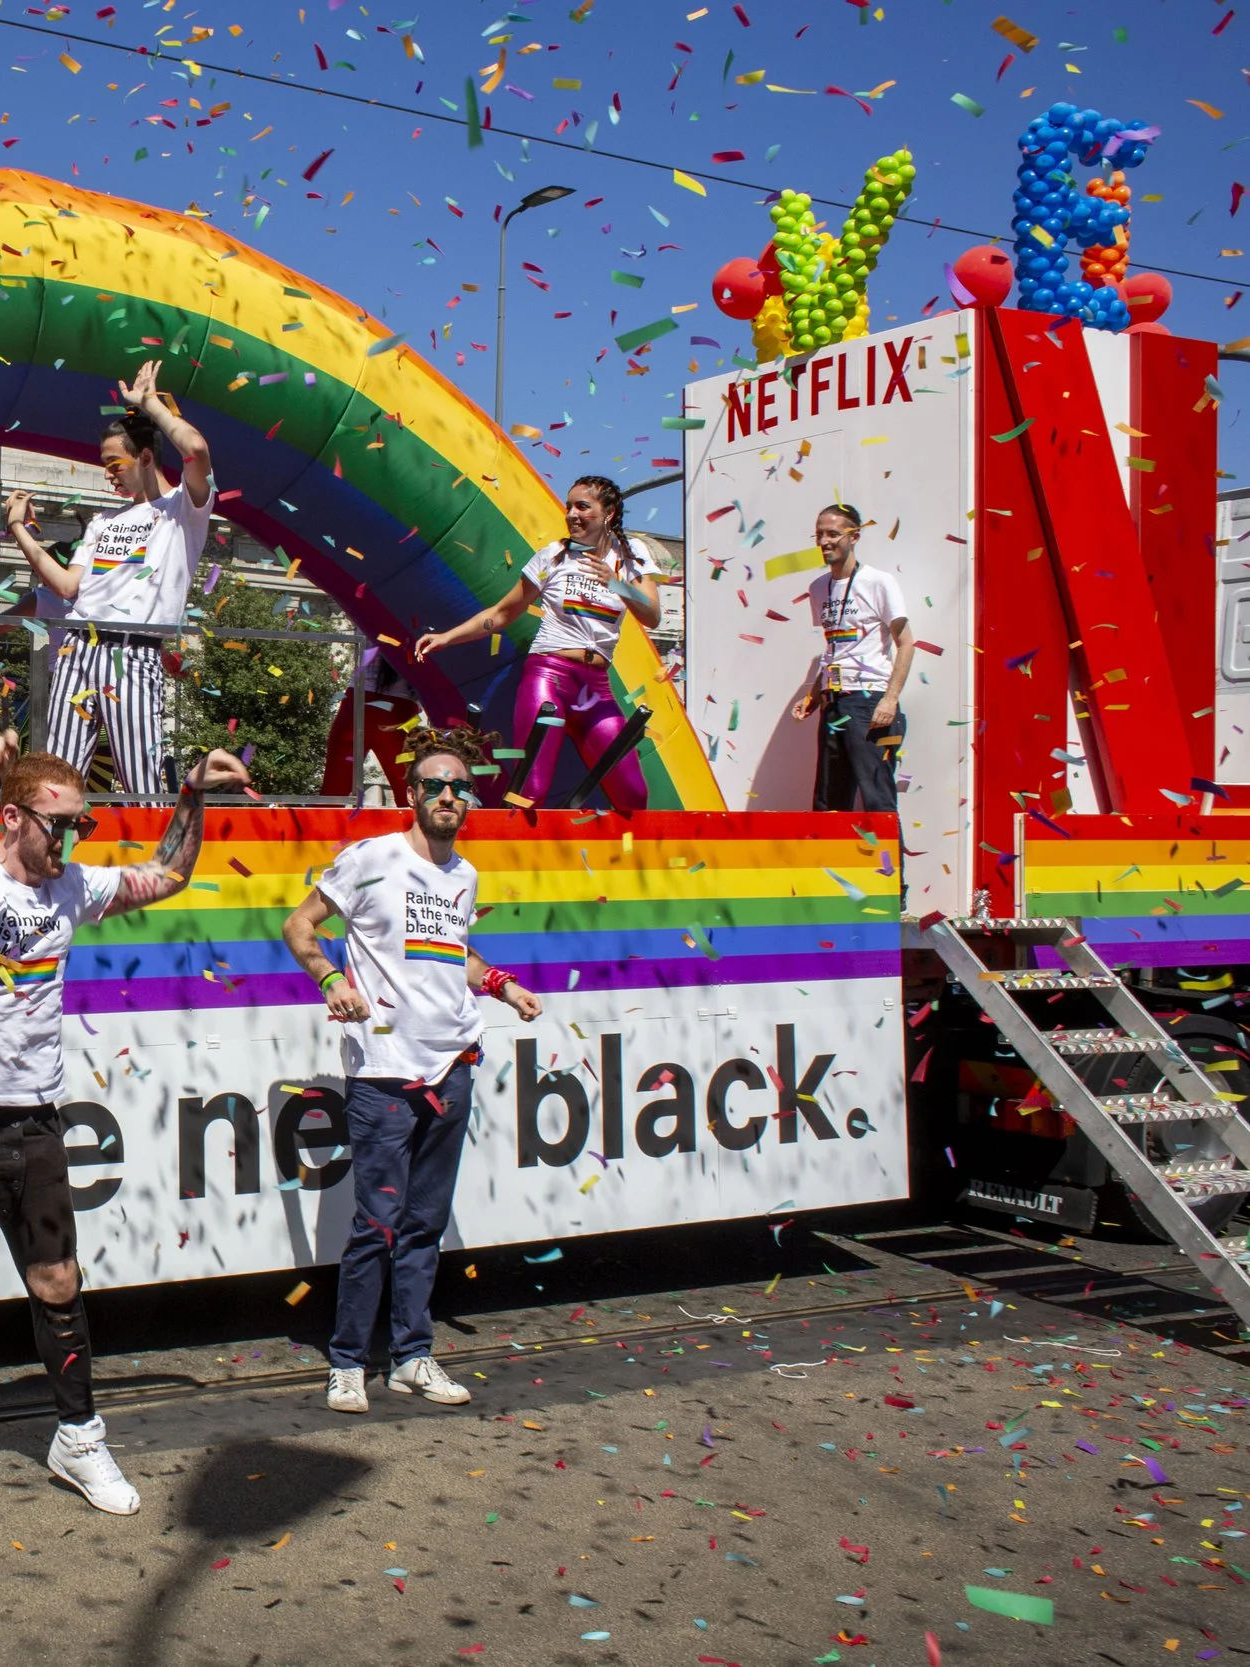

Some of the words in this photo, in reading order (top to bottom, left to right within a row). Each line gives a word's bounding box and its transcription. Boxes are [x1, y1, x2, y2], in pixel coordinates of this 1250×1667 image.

[728, 336, 914, 443] NETFLIX
[113, 535, 133, 544] the
[95, 543, 133, 556] black.
[565, 587, 602, 602] black.
[405, 905, 417, 919] is
[420, 907, 442, 921] the
[444, 913, 466, 927] new
[405, 919, 447, 936] black.
[178, 1091, 353, 1201] ne
[515, 1022, 868, 1168] black.
[967, 1179, 1063, 1215] RENAULT
